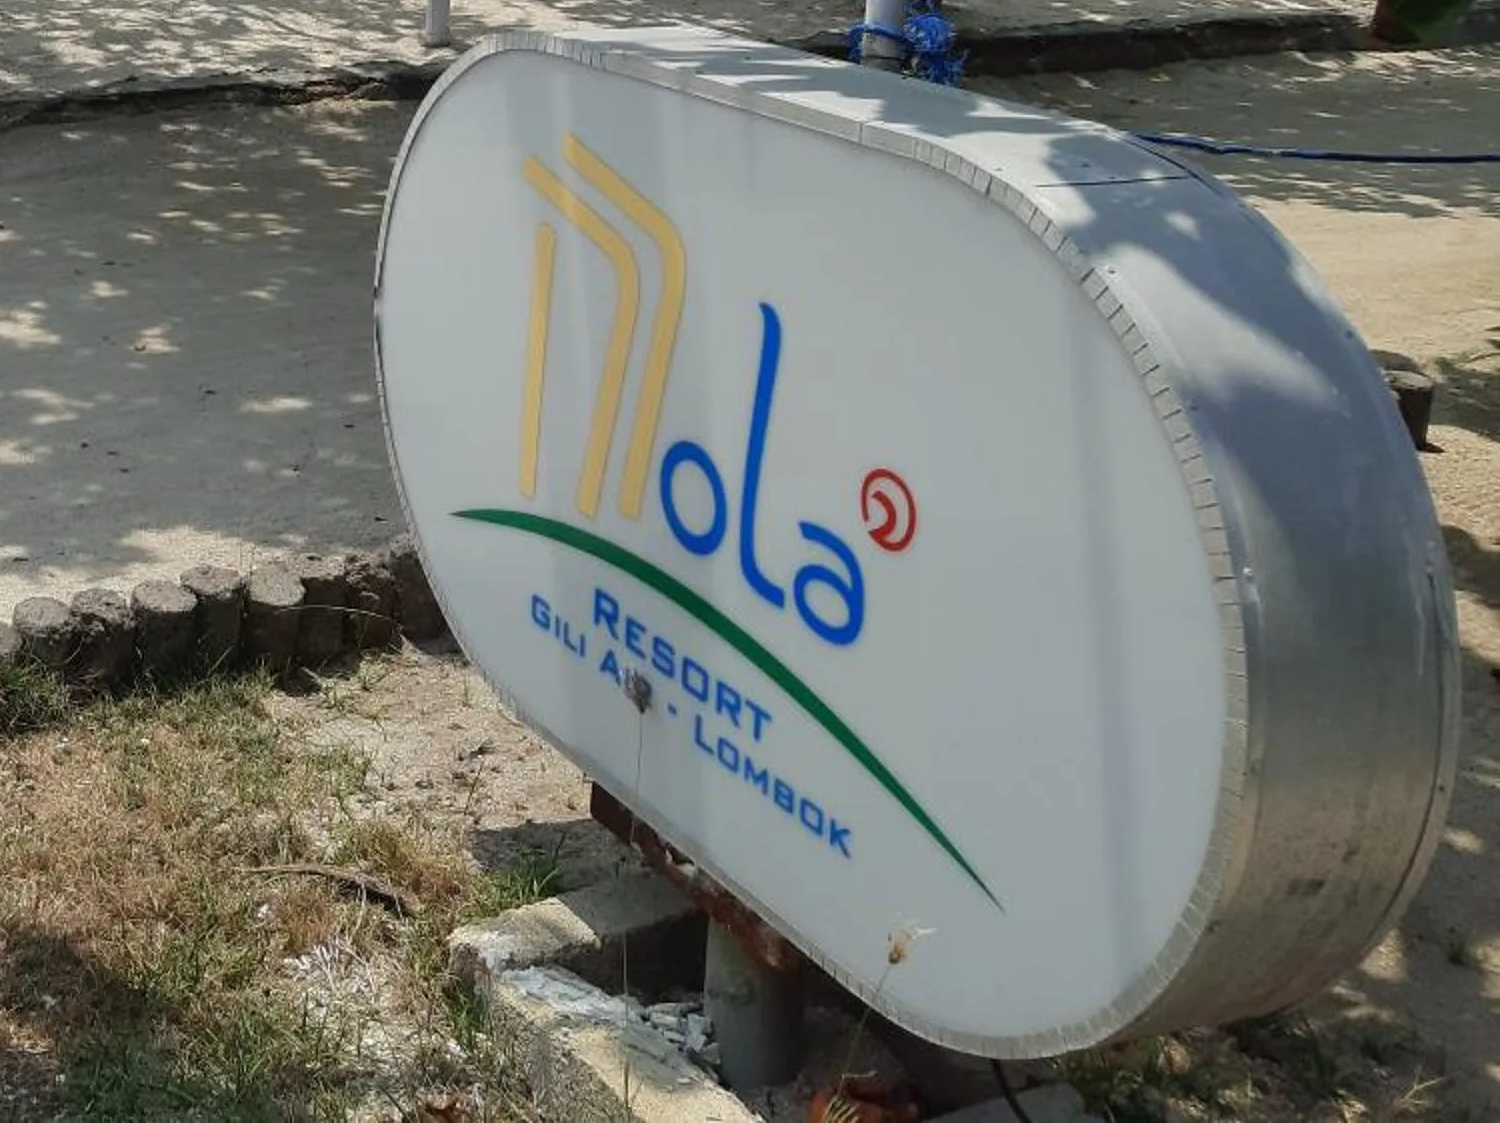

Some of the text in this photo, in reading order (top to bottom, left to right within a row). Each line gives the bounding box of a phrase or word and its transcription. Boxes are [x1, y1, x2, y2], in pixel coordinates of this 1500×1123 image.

[520, 131, 868, 649] Mola
[530, 593, 587, 658] GILI
[694, 713, 851, 858] LOMBOK
[591, 587, 773, 743] RESORT
